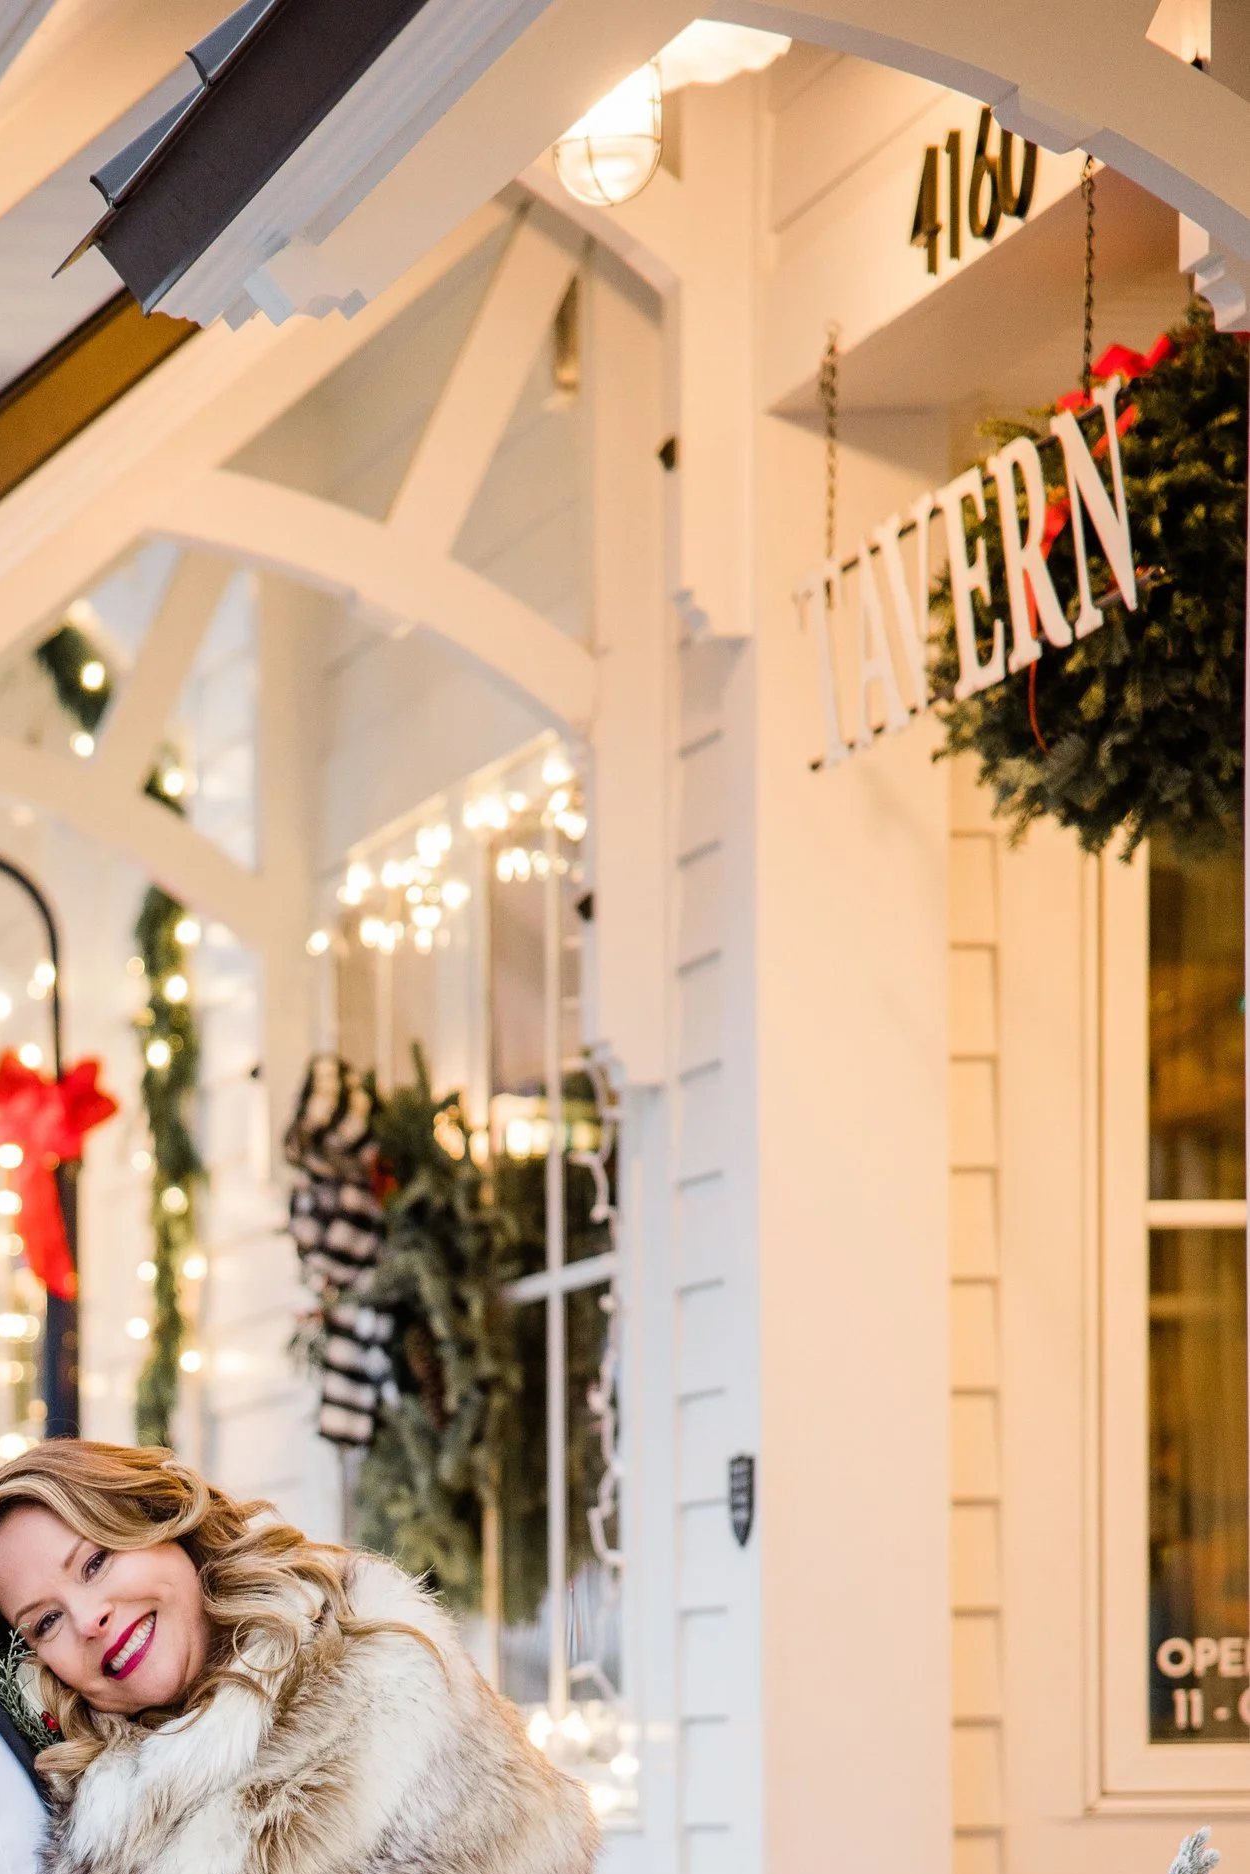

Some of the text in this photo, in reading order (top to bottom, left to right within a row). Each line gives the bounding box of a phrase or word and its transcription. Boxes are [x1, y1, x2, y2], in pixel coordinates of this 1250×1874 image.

[910, 105, 1038, 276] 4160
[792, 374, 1140, 768] TAVERN
[1156, 1636, 1250, 1679] OPE
